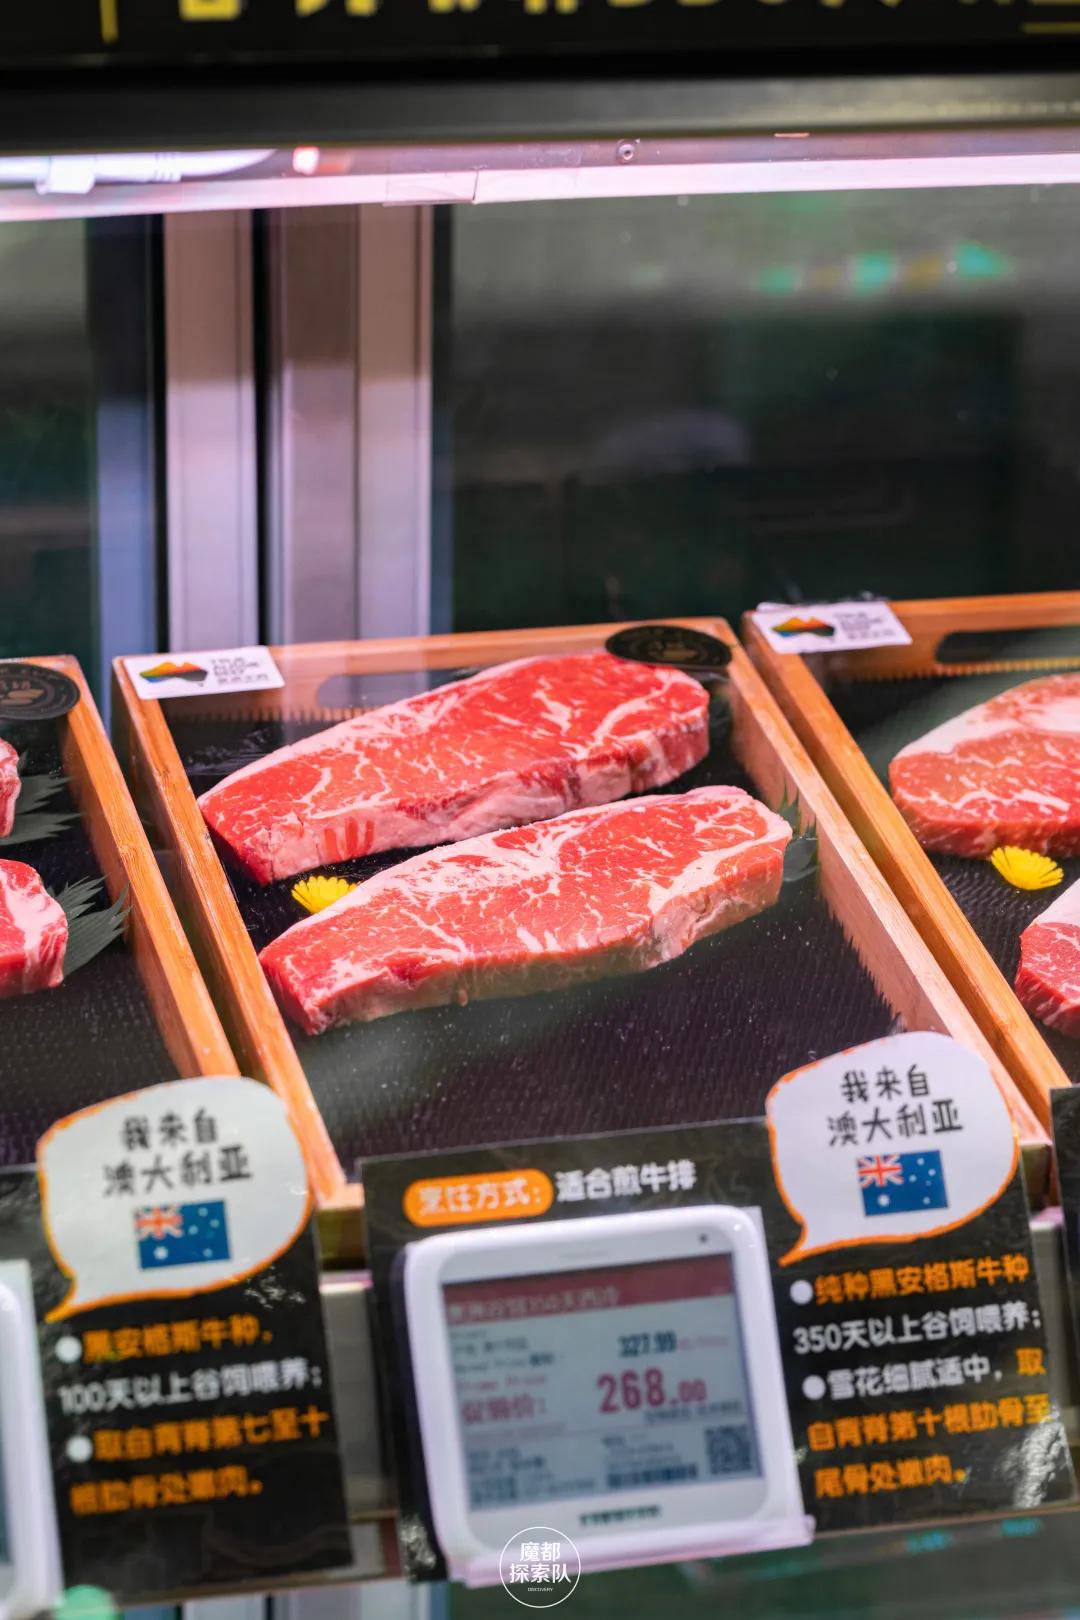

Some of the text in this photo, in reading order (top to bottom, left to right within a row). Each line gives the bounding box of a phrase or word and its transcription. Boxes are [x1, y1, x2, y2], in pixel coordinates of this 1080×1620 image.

[841, 1064, 930, 1103] 我来自
[122, 1107, 218, 1150] 我来自
[827, 1098, 964, 1147] 澳大利亚
[102, 1144, 254, 1197] 澳大利亚
